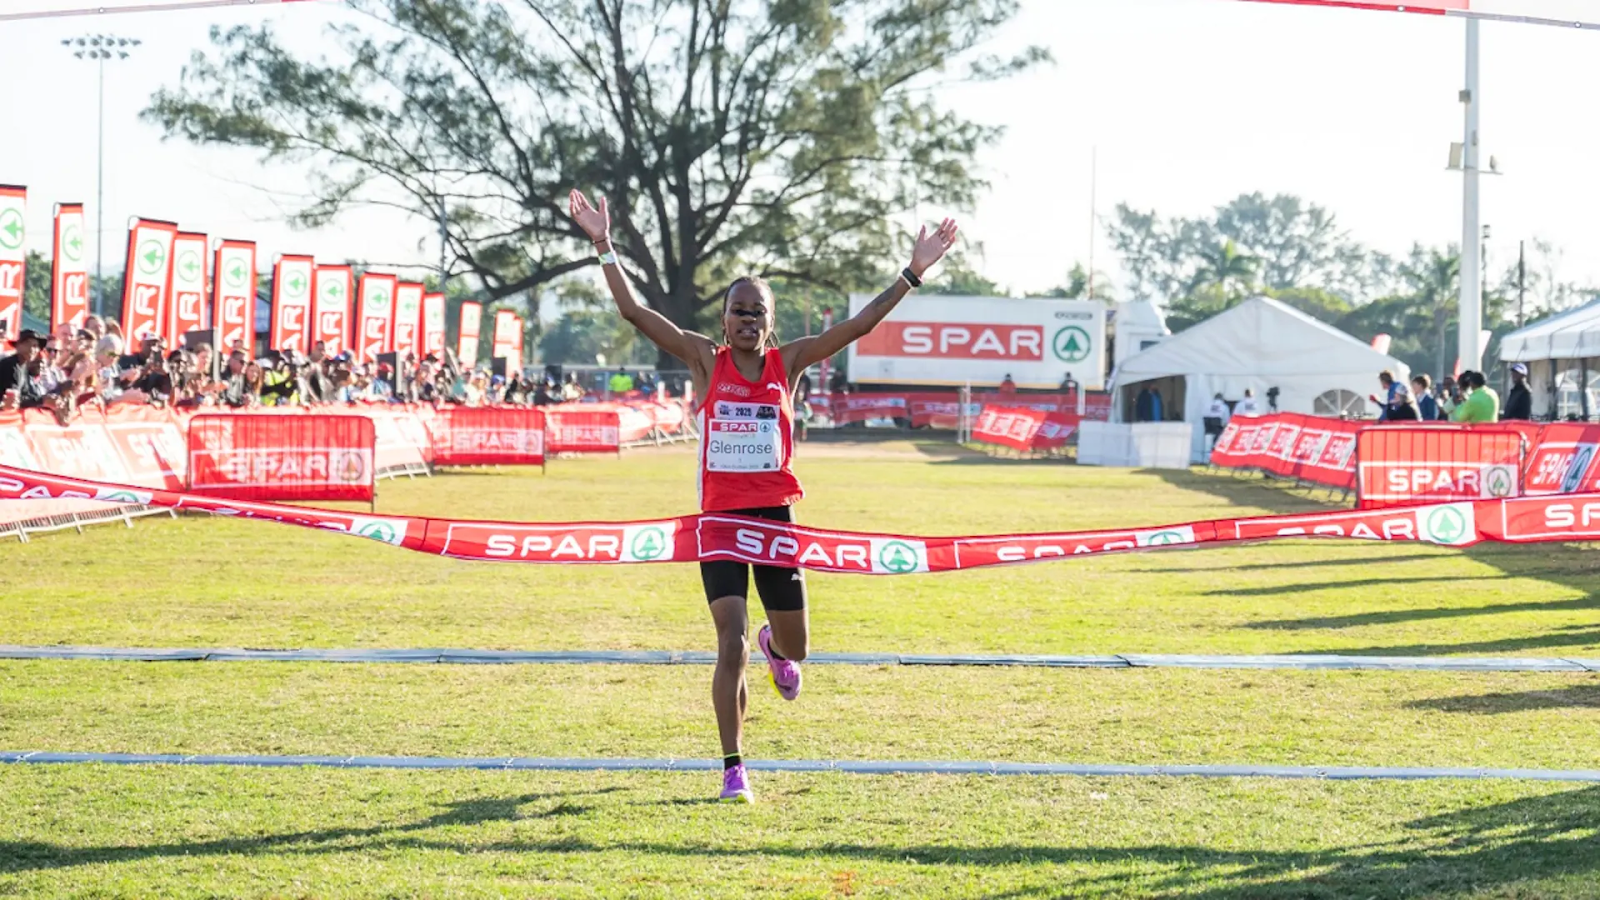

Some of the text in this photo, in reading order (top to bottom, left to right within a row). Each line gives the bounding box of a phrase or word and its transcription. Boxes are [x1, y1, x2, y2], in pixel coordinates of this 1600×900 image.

[902, 326, 1041, 356] SPAR
[720, 423, 757, 432] SPAR
[710, 440, 772, 454] Glenrose
[1388, 468, 1480, 492] SPAR
[485, 535, 619, 558] SPAR
[736, 528, 867, 568] SPAR
